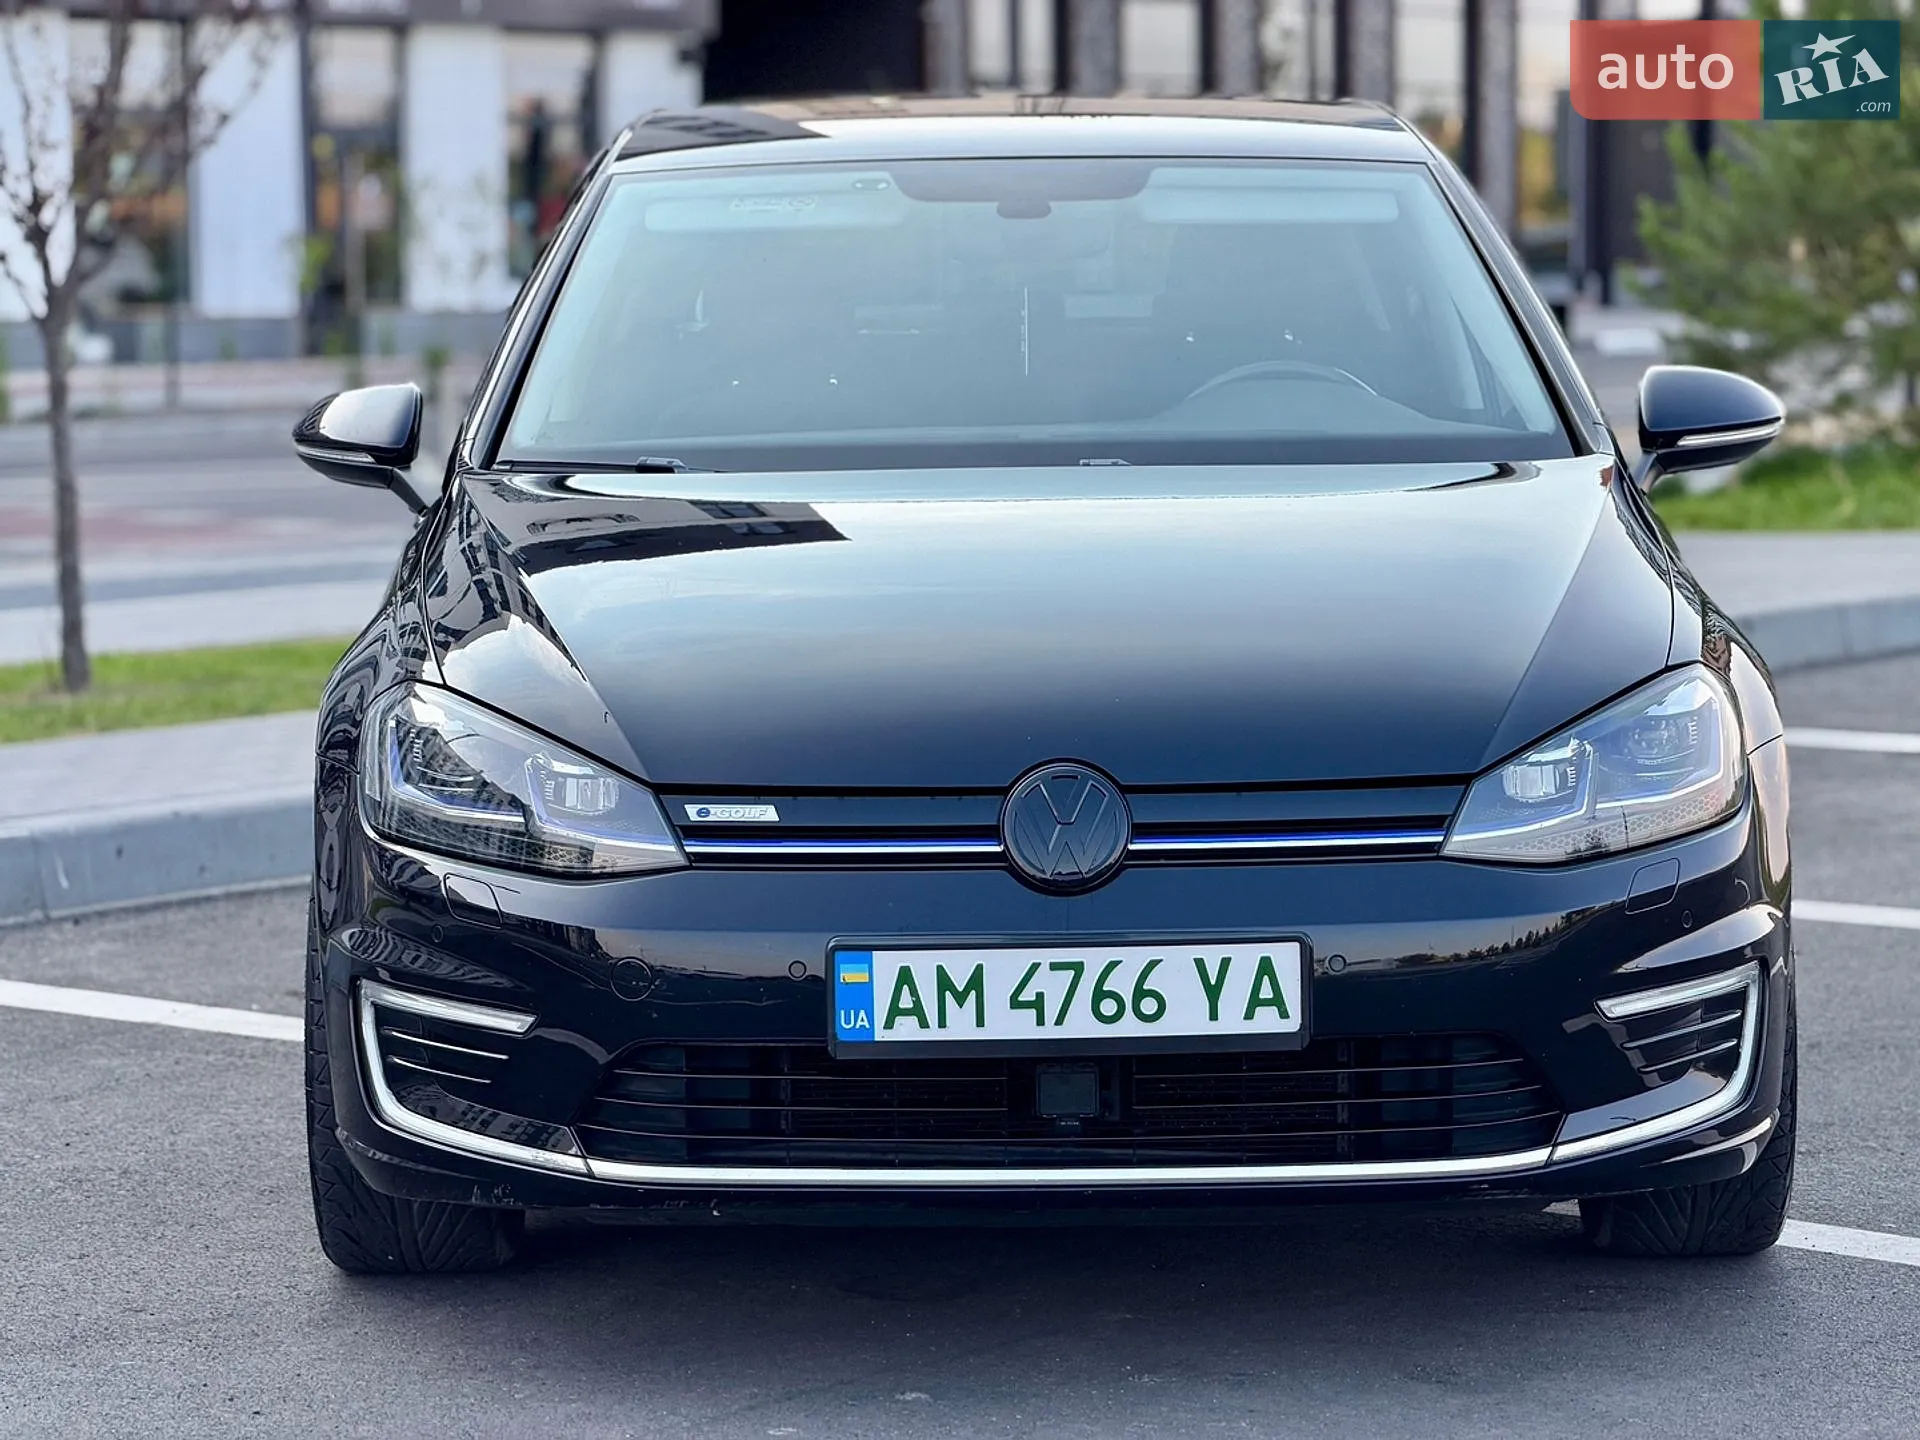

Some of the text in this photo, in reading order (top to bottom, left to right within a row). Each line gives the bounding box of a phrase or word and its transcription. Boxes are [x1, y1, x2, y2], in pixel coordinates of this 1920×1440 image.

[882, 955, 1291, 1029] AM 4766 YA
[840, 1009, 870, 1029] UA
